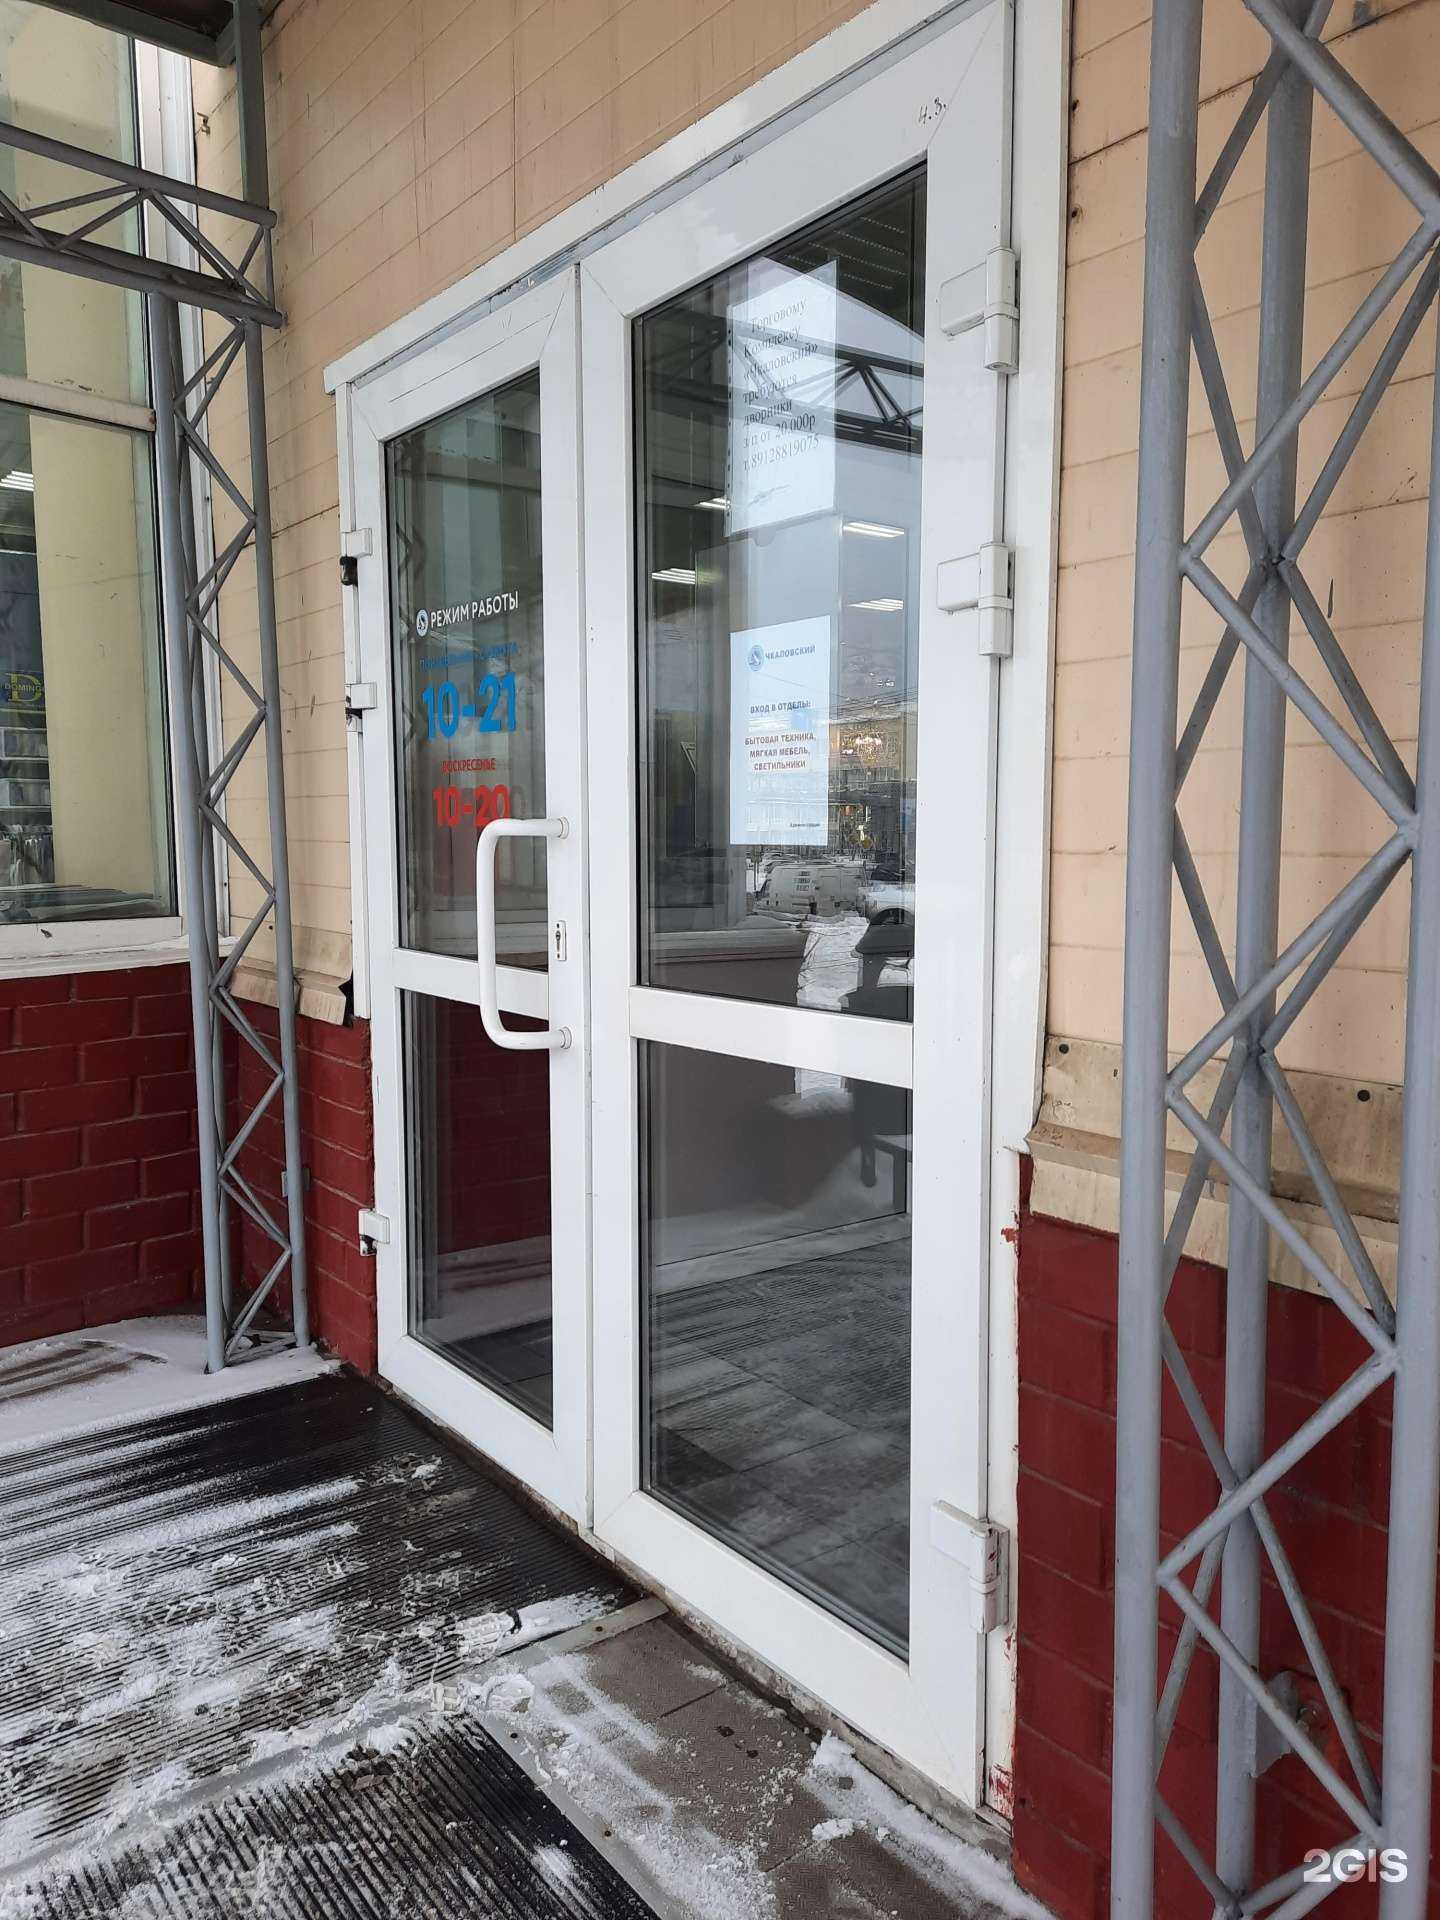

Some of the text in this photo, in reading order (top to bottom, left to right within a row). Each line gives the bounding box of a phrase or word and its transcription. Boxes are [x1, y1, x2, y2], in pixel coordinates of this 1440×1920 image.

[743, 399, 793, 428] дворники
[430, 590, 520, 629] РЕЖИМ РАБОТЫ
[765, 644, 816, 661] ЧКАЛОВСКИЙ
[422, 671, 518, 741] 10-21
[750, 701, 770, 714] ВХОД
[744, 731, 817, 746] БЫТОВАЯ ТЕХНИКА,
[749, 747, 811, 759] МЯГКАЯ МЕБЕЛЬ,
[754, 760, 806, 771] СВЕТИЛЬНИКИ
[433, 783, 511, 828] 10-20
